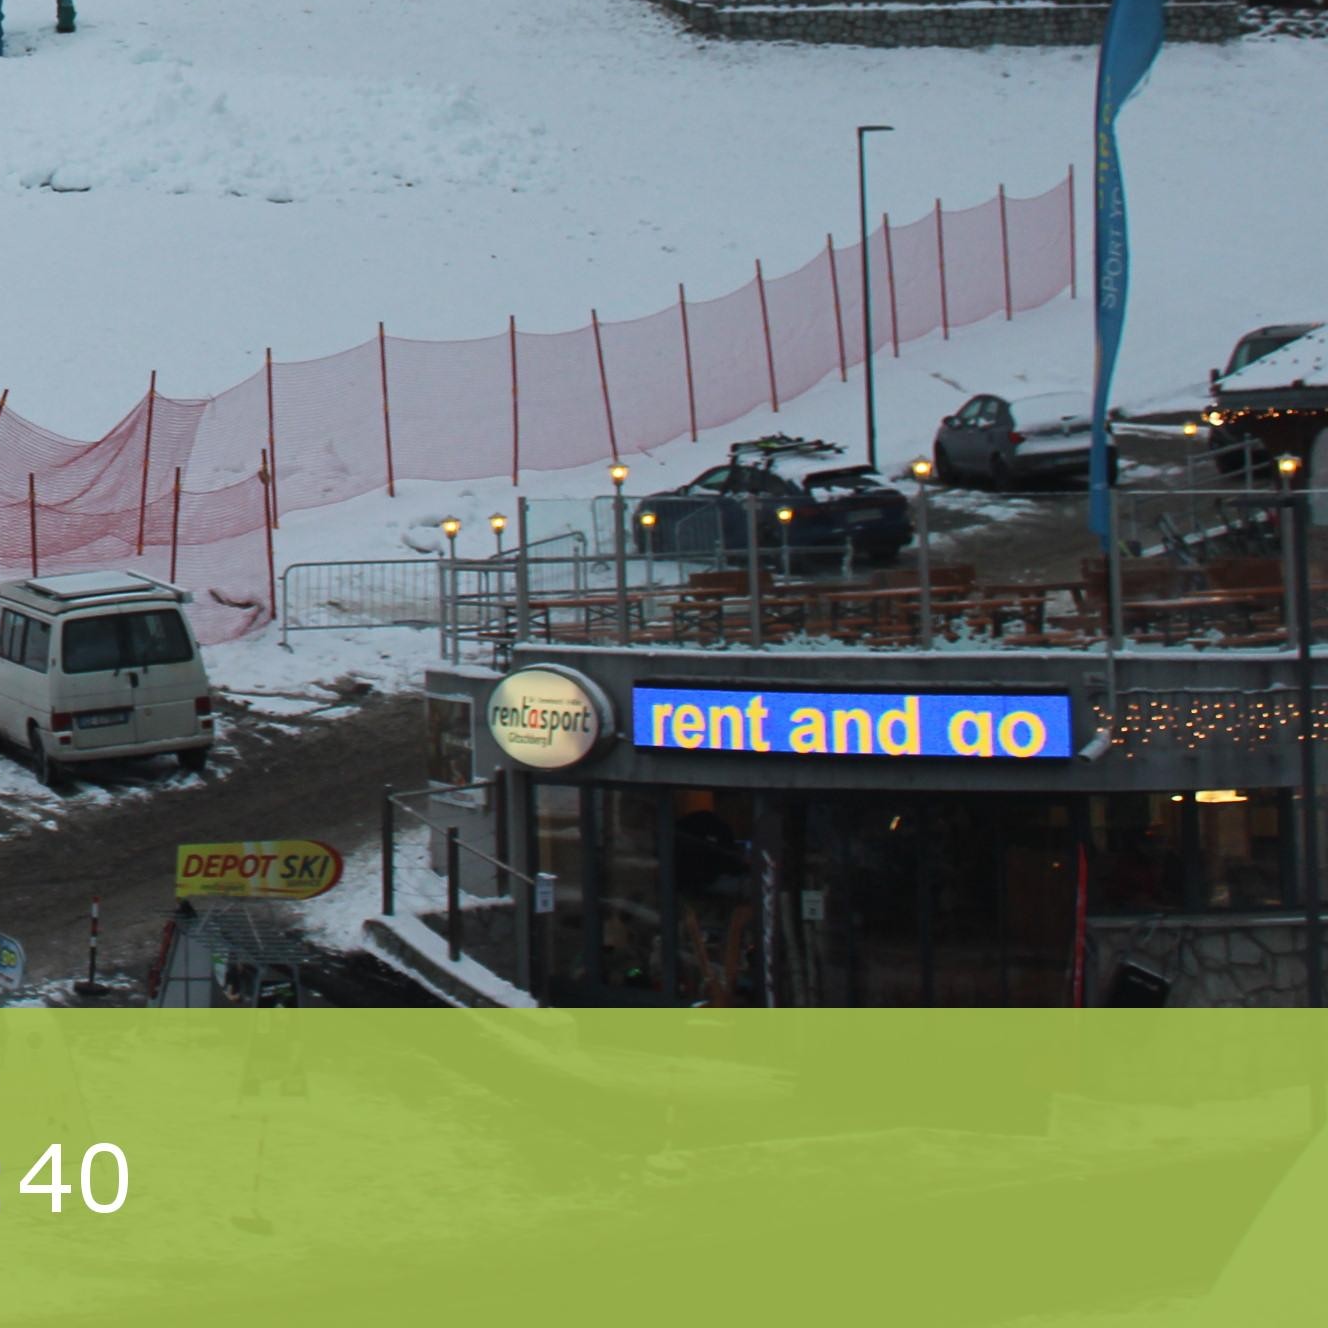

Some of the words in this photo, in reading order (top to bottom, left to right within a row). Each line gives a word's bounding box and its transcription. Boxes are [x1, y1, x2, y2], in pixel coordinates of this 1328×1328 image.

[491, 695, 593, 746] rentasport
[652, 695, 771, 753] rent
[788, 695, 921, 756] and
[181, 854, 278, 878] DEPOT
[280, 854, 331, 880] SKI
